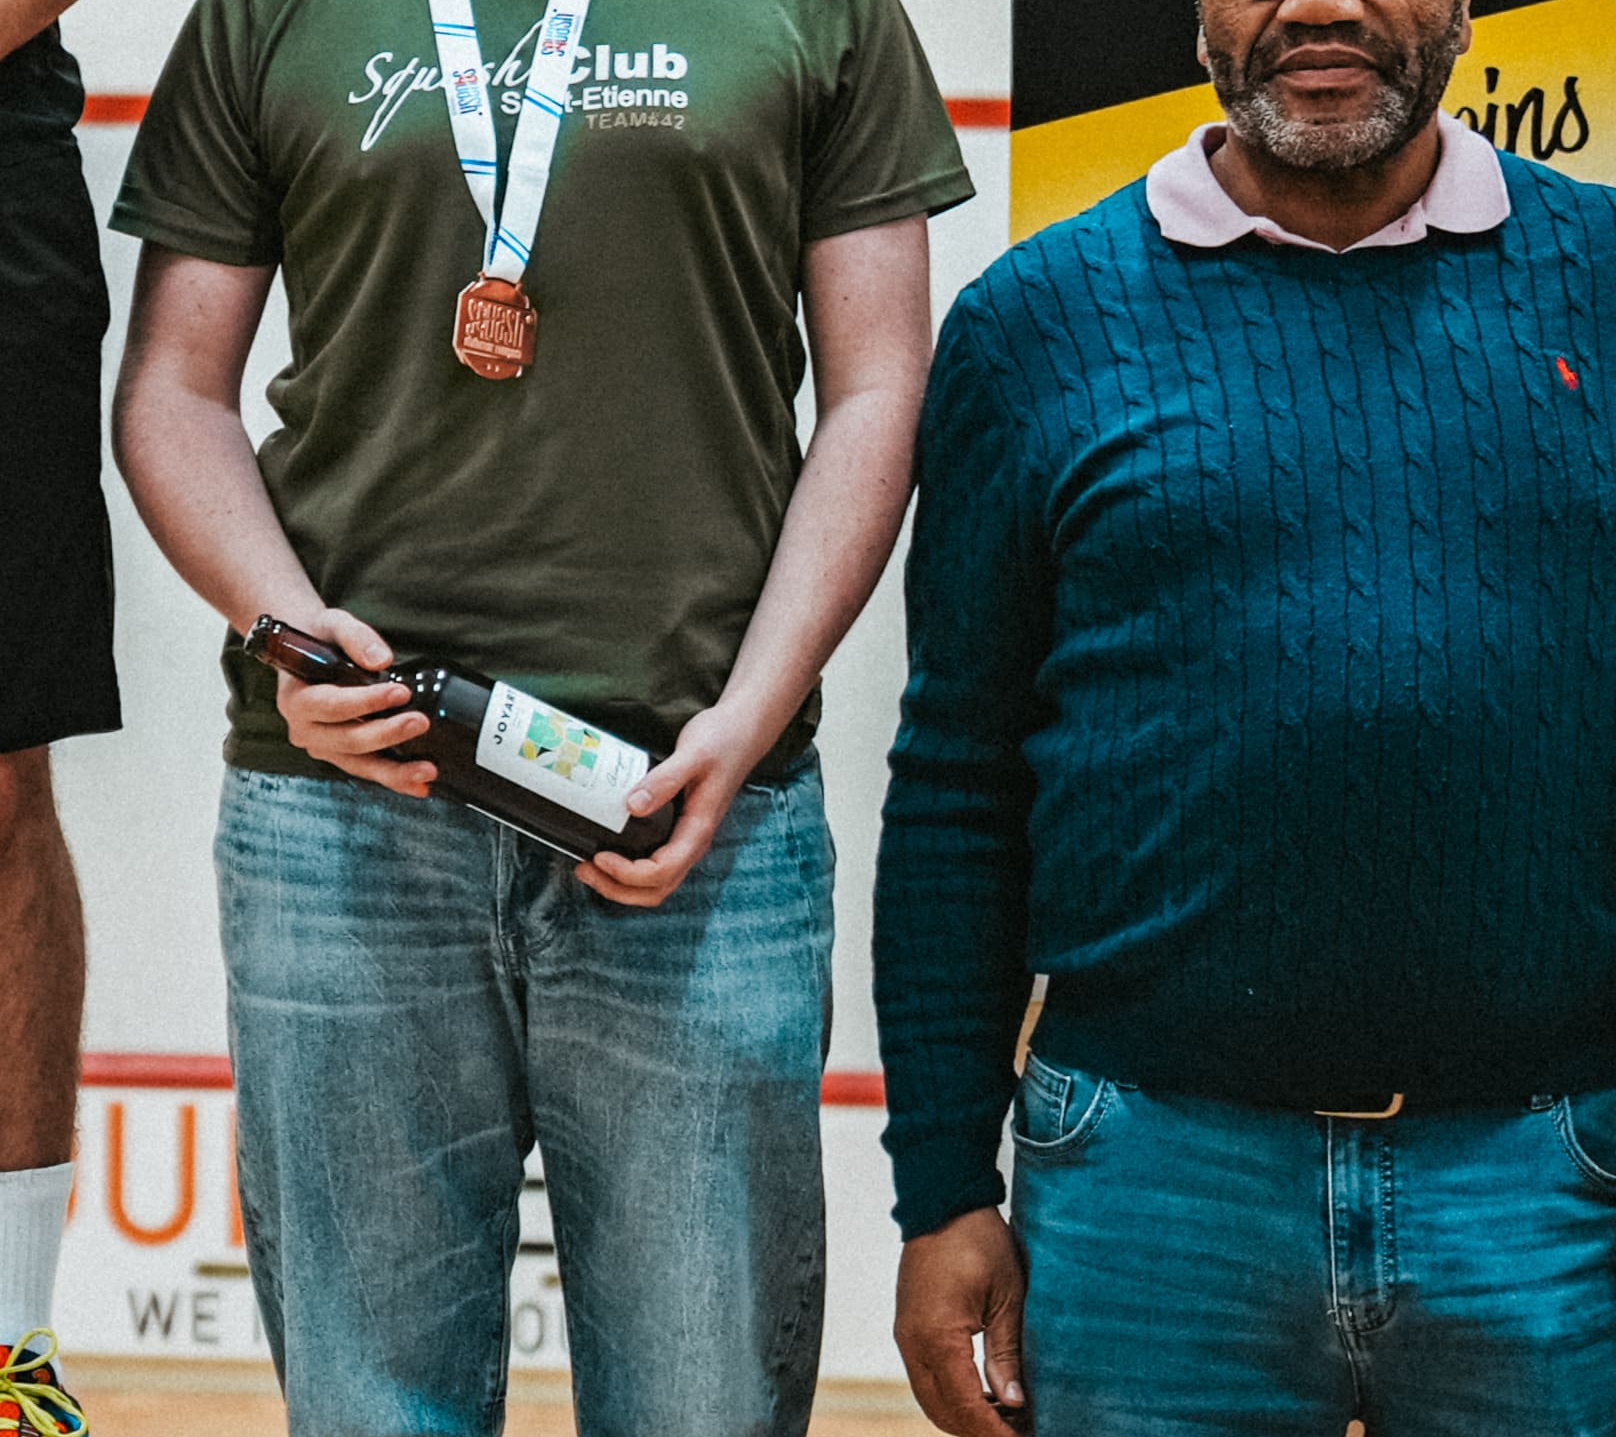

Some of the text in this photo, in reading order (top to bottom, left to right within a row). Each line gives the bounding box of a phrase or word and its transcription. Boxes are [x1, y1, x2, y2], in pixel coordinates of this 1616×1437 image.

[348, 18, 545, 151] Sqush
[500, 85, 688, 115] St-Etienne
[585, 113, 685, 131] TEAM#42
[127, 1288, 221, 1343] WE
